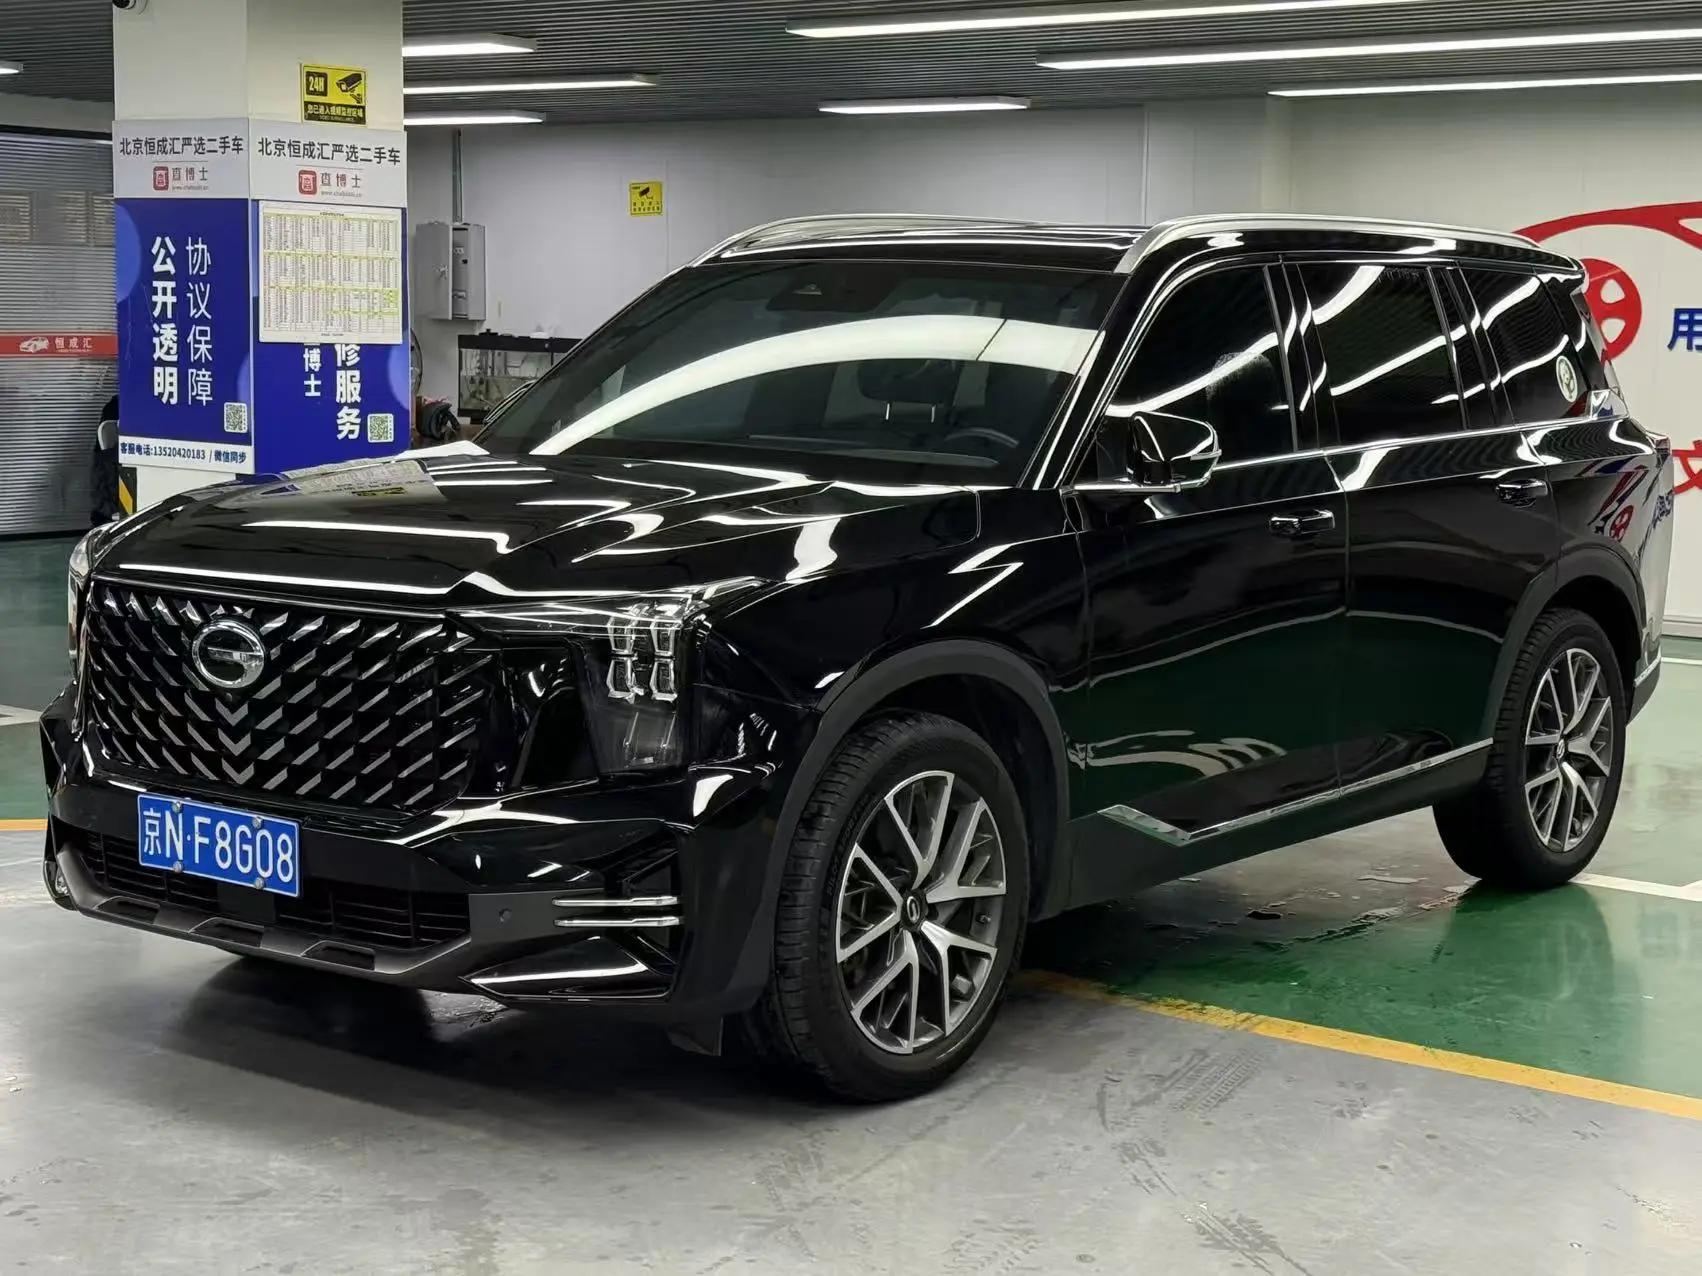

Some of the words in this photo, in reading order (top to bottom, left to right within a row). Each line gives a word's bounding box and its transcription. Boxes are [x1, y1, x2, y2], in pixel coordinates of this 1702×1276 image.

[308, 76, 325, 92] 24H
[119, 136, 244, 156] 北京恒成汇严选二手车
[258, 137, 401, 166] 北京恒成汇严选二手车
[151, 236, 178, 405] 公开透明
[186, 236, 213, 406] 协议保障
[1667, 308, 1702, 352] 用
[55, 336, 93, 349] 恒成汇
[303, 342, 321, 397] 博士
[214, 450, 247, 464] 微信同步
[143, 808, 294, 883] 京N·F8G08
